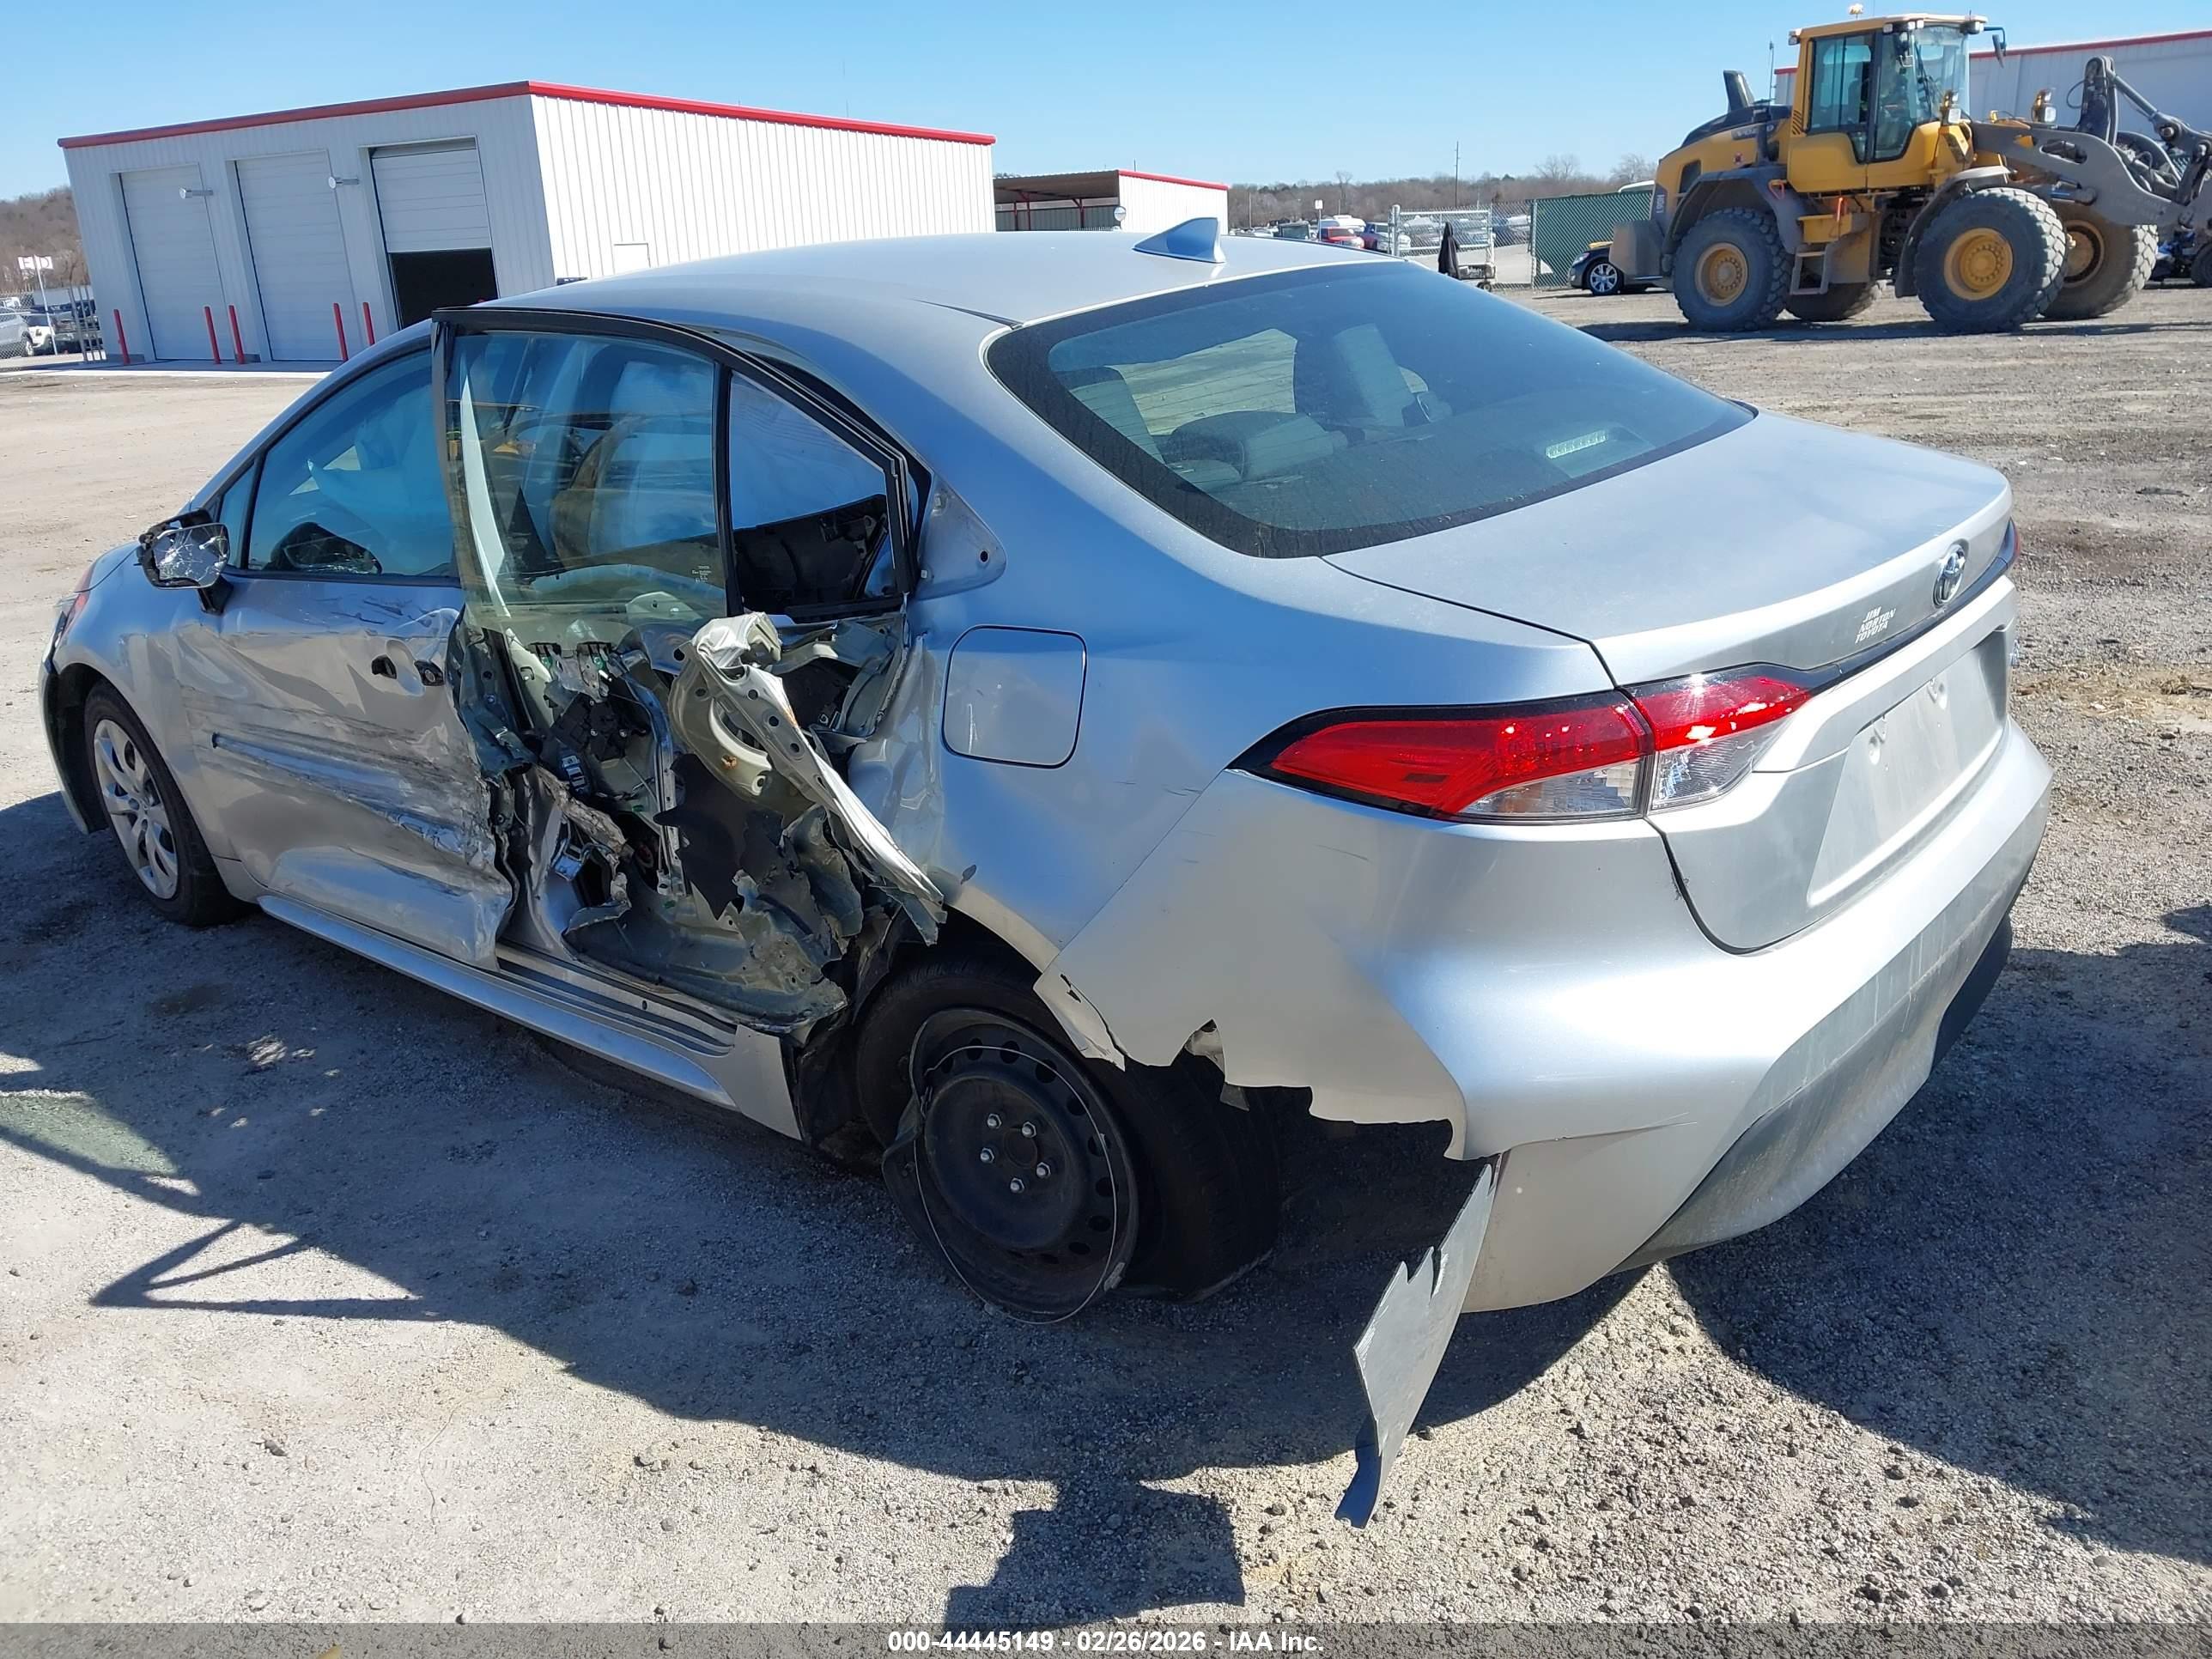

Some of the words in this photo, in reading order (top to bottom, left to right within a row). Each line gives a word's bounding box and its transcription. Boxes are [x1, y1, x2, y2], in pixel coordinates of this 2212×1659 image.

[1859, 608, 1896, 633] NORTON
[1863, 606, 1881, 623] JIM
[1855, 620, 1889, 644] TOYOTA
